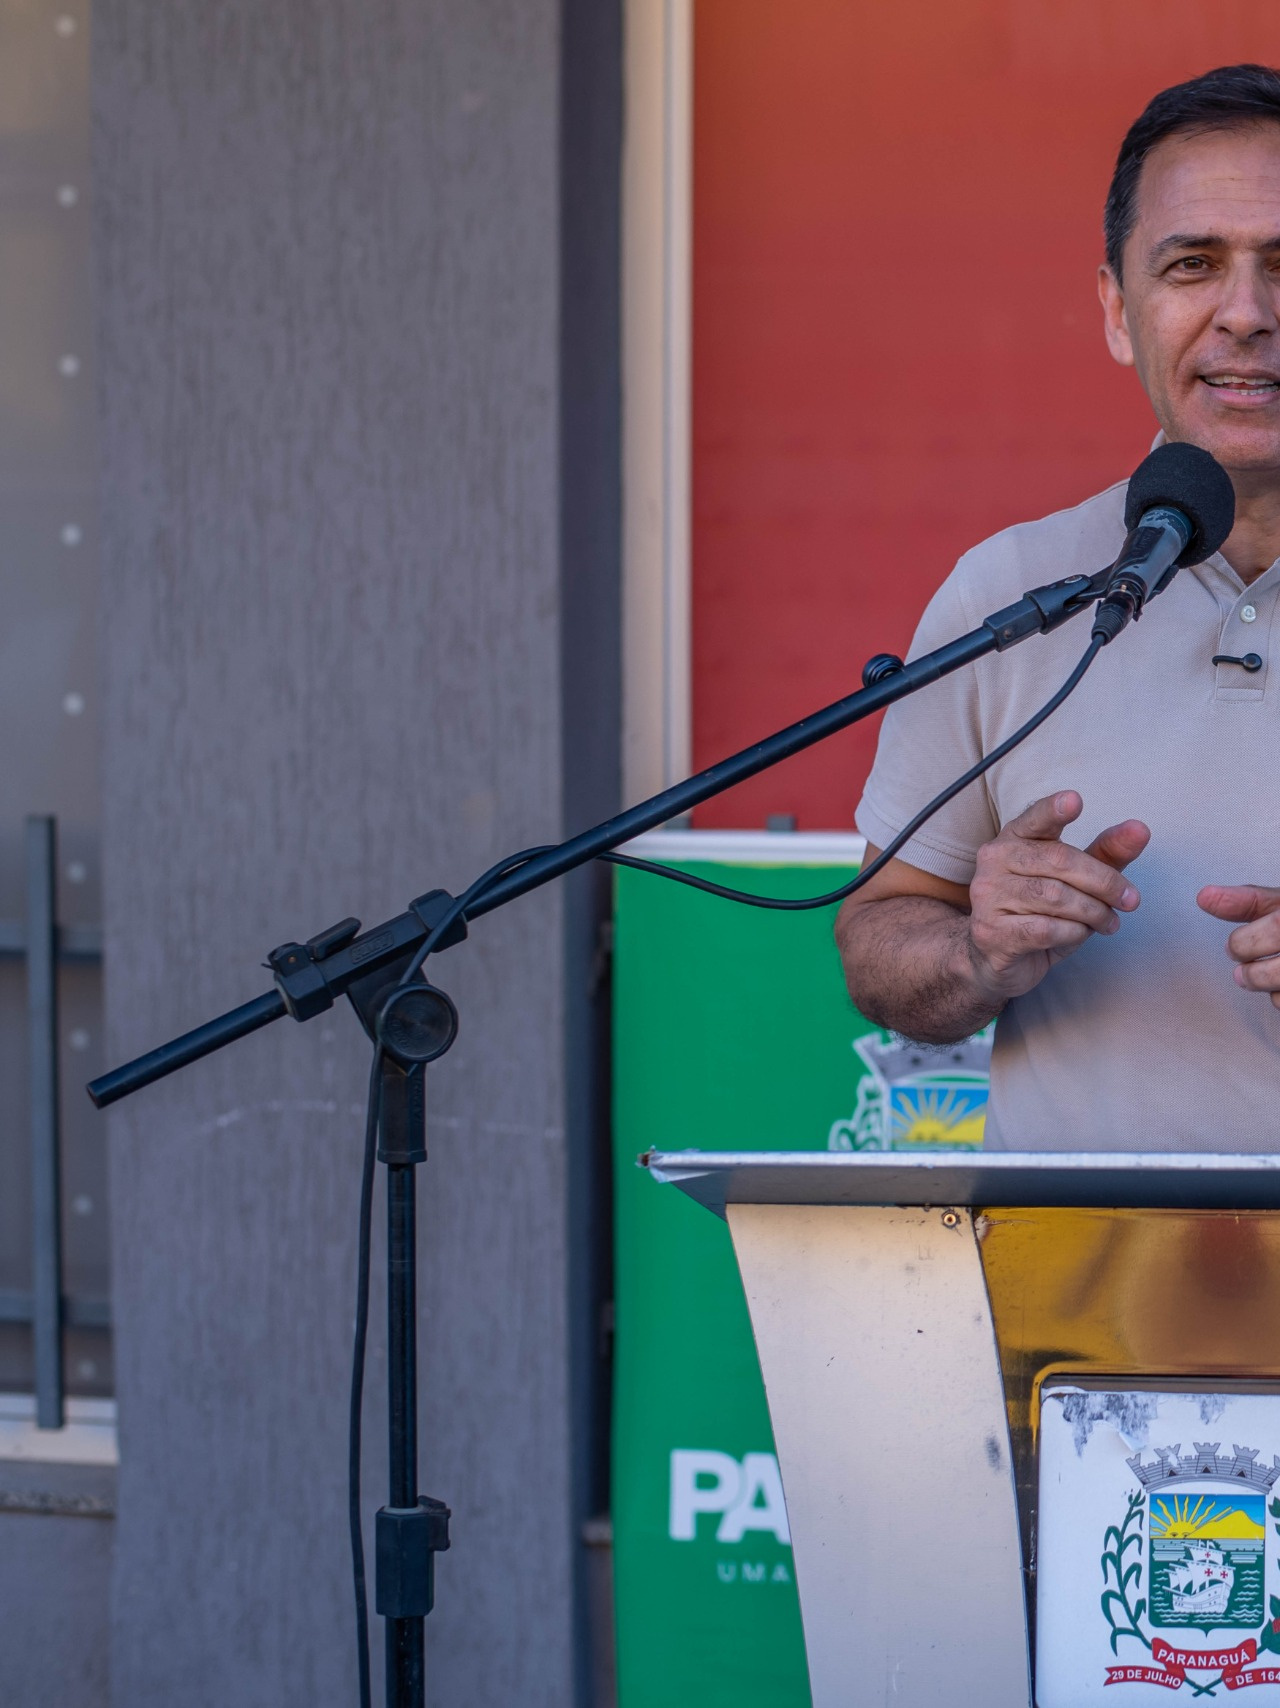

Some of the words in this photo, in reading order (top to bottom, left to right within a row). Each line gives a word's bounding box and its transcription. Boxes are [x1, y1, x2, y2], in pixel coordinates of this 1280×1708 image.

[716, 1562, 791, 1583] UMA
[1157, 1648, 1251, 1667] PARANAGUÁ
[1111, 1670, 1125, 1681] 29
[1127, 1669, 1142, 1679] DE
[1144, 1670, 1182, 1688] JULHO
[1235, 1672, 1254, 1687] DE
